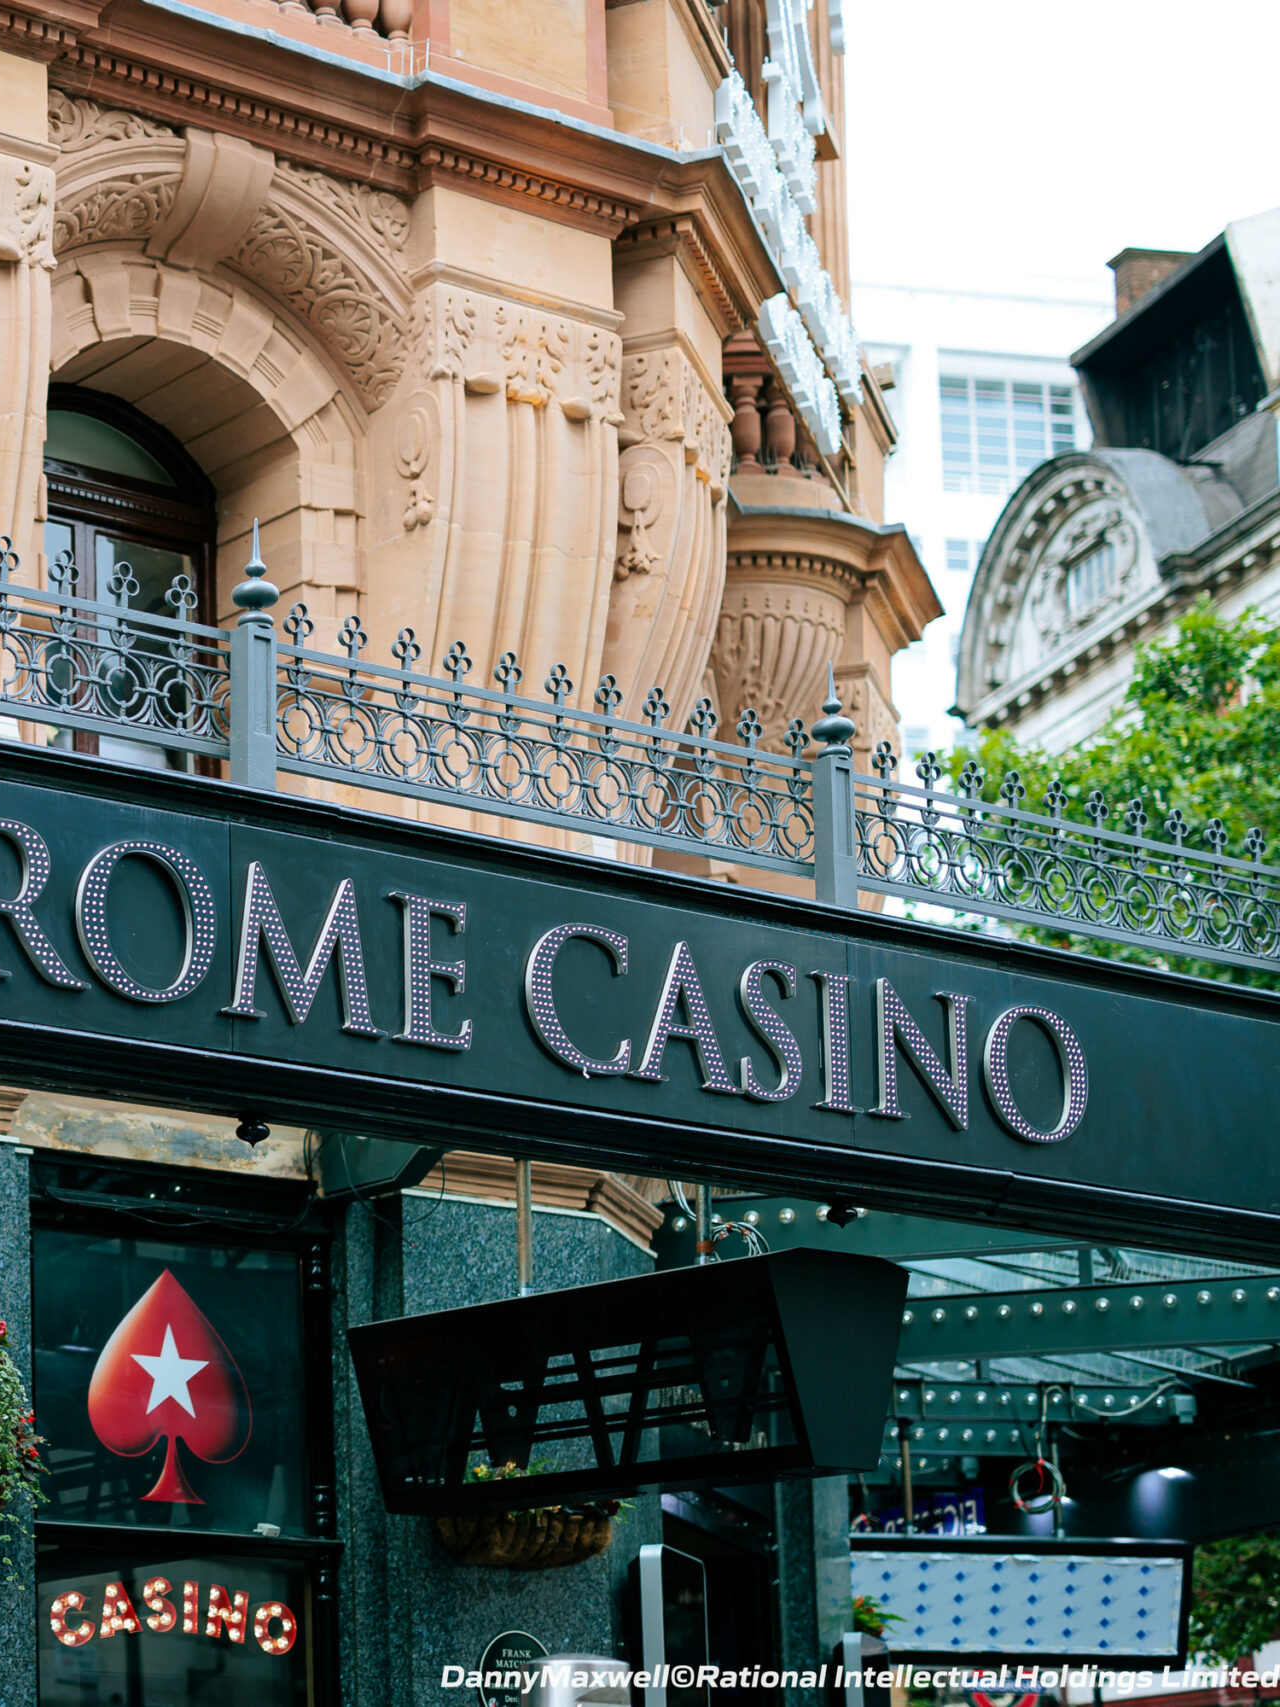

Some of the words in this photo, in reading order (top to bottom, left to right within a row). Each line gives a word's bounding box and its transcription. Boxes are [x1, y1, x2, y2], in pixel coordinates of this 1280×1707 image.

[524, 921, 1090, 1146] CASINO
[50, 1576, 297, 1655] CASINO
[502, 1649, 531, 1658] FRANK
